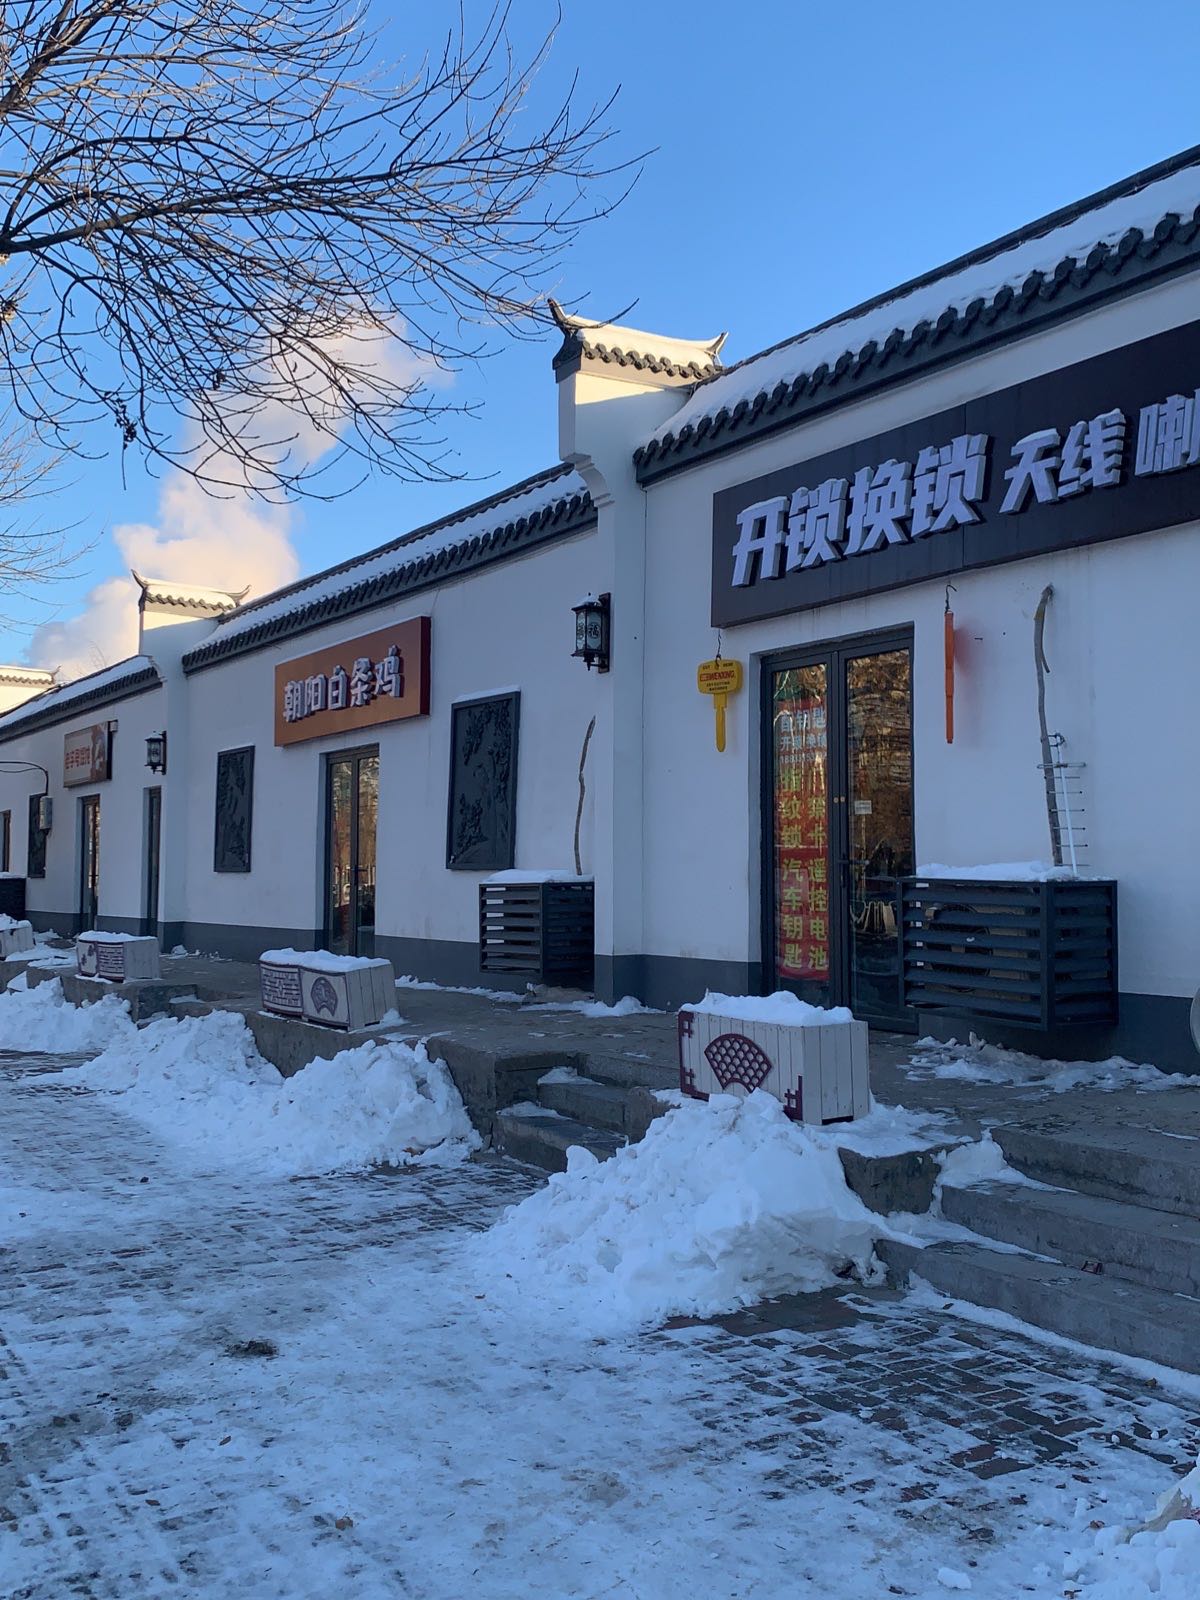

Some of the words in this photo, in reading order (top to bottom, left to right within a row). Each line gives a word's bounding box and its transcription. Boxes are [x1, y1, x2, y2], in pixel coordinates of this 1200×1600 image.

[731, 433, 989, 587] 开锁换锁
[999, 408, 1127, 514] 天线
[283, 644, 401, 723] 朝阳白条鸡
[782, 858, 804, 969] 汽车钥匙
[808, 857, 829, 970] 遥控电池
